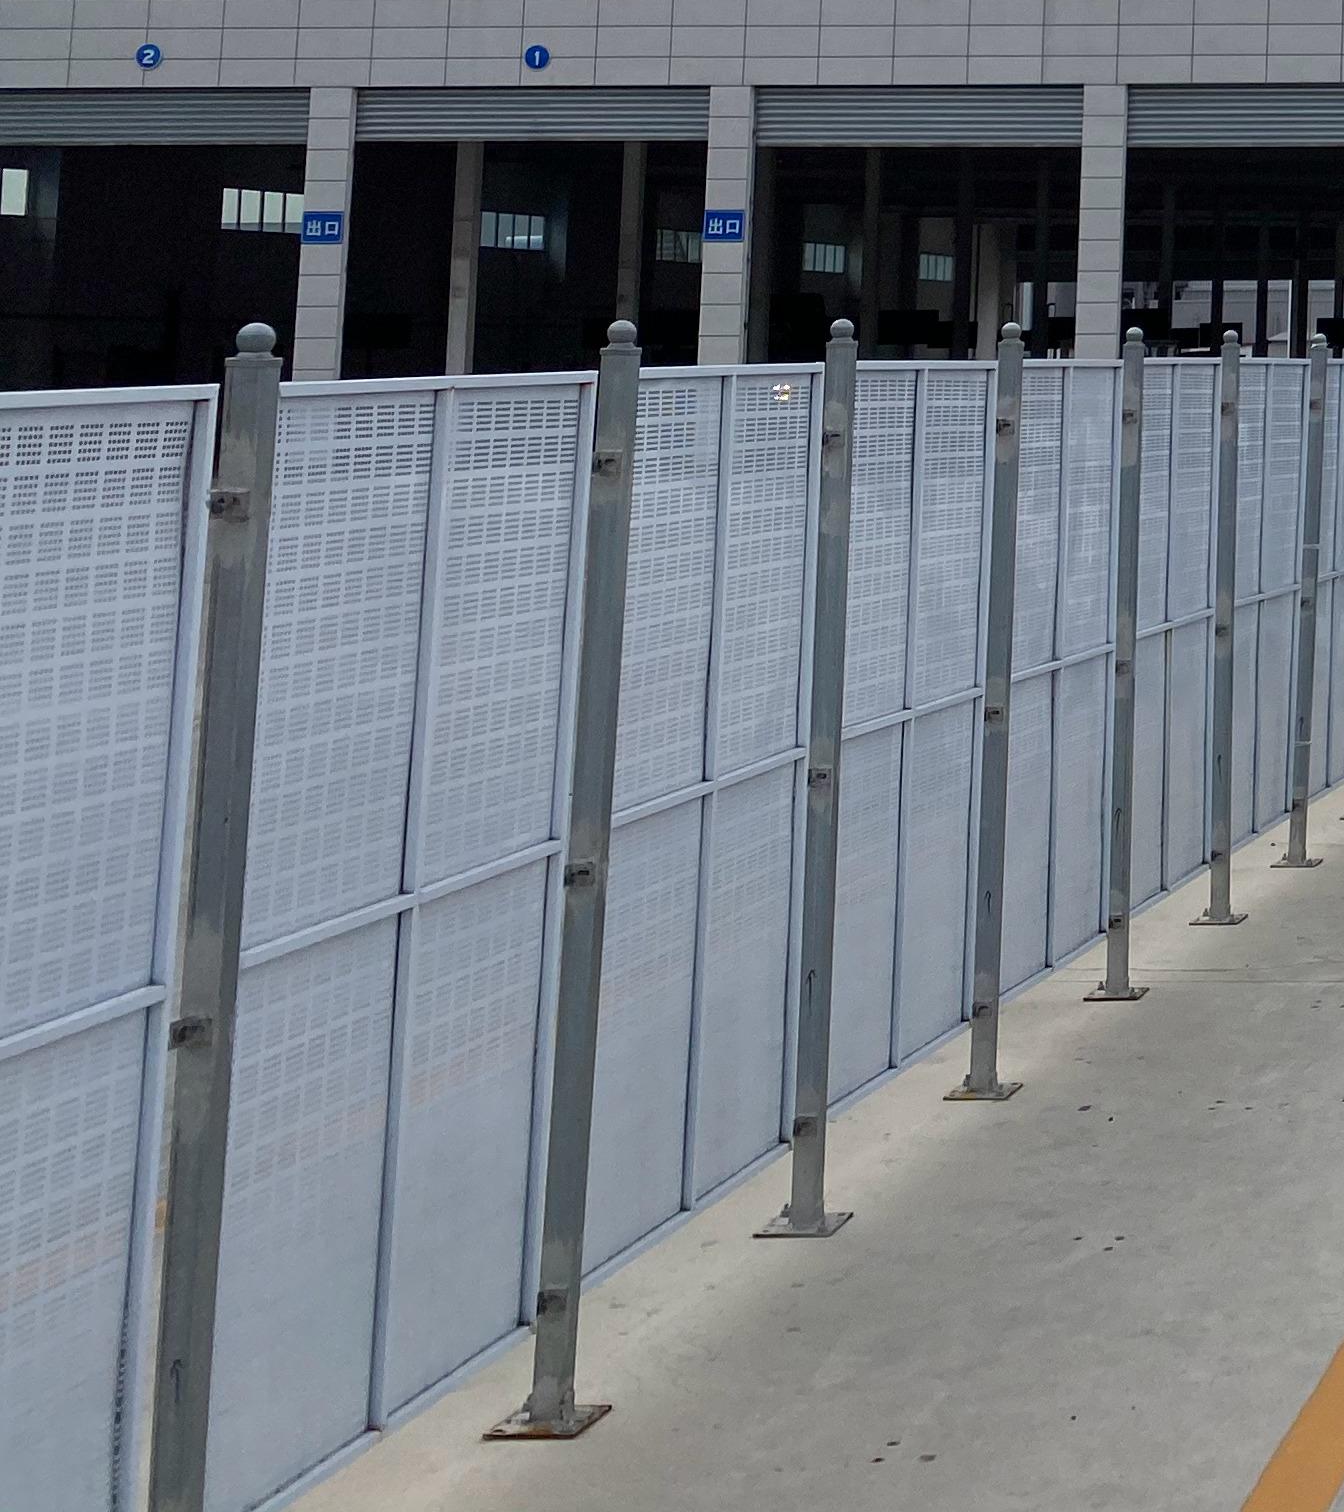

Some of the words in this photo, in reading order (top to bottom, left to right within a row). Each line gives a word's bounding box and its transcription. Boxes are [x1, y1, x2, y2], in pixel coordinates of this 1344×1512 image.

[142, 49, 155, 64] 2
[306, 220, 339, 236] 出口
[708, 218, 740, 234] 出口
